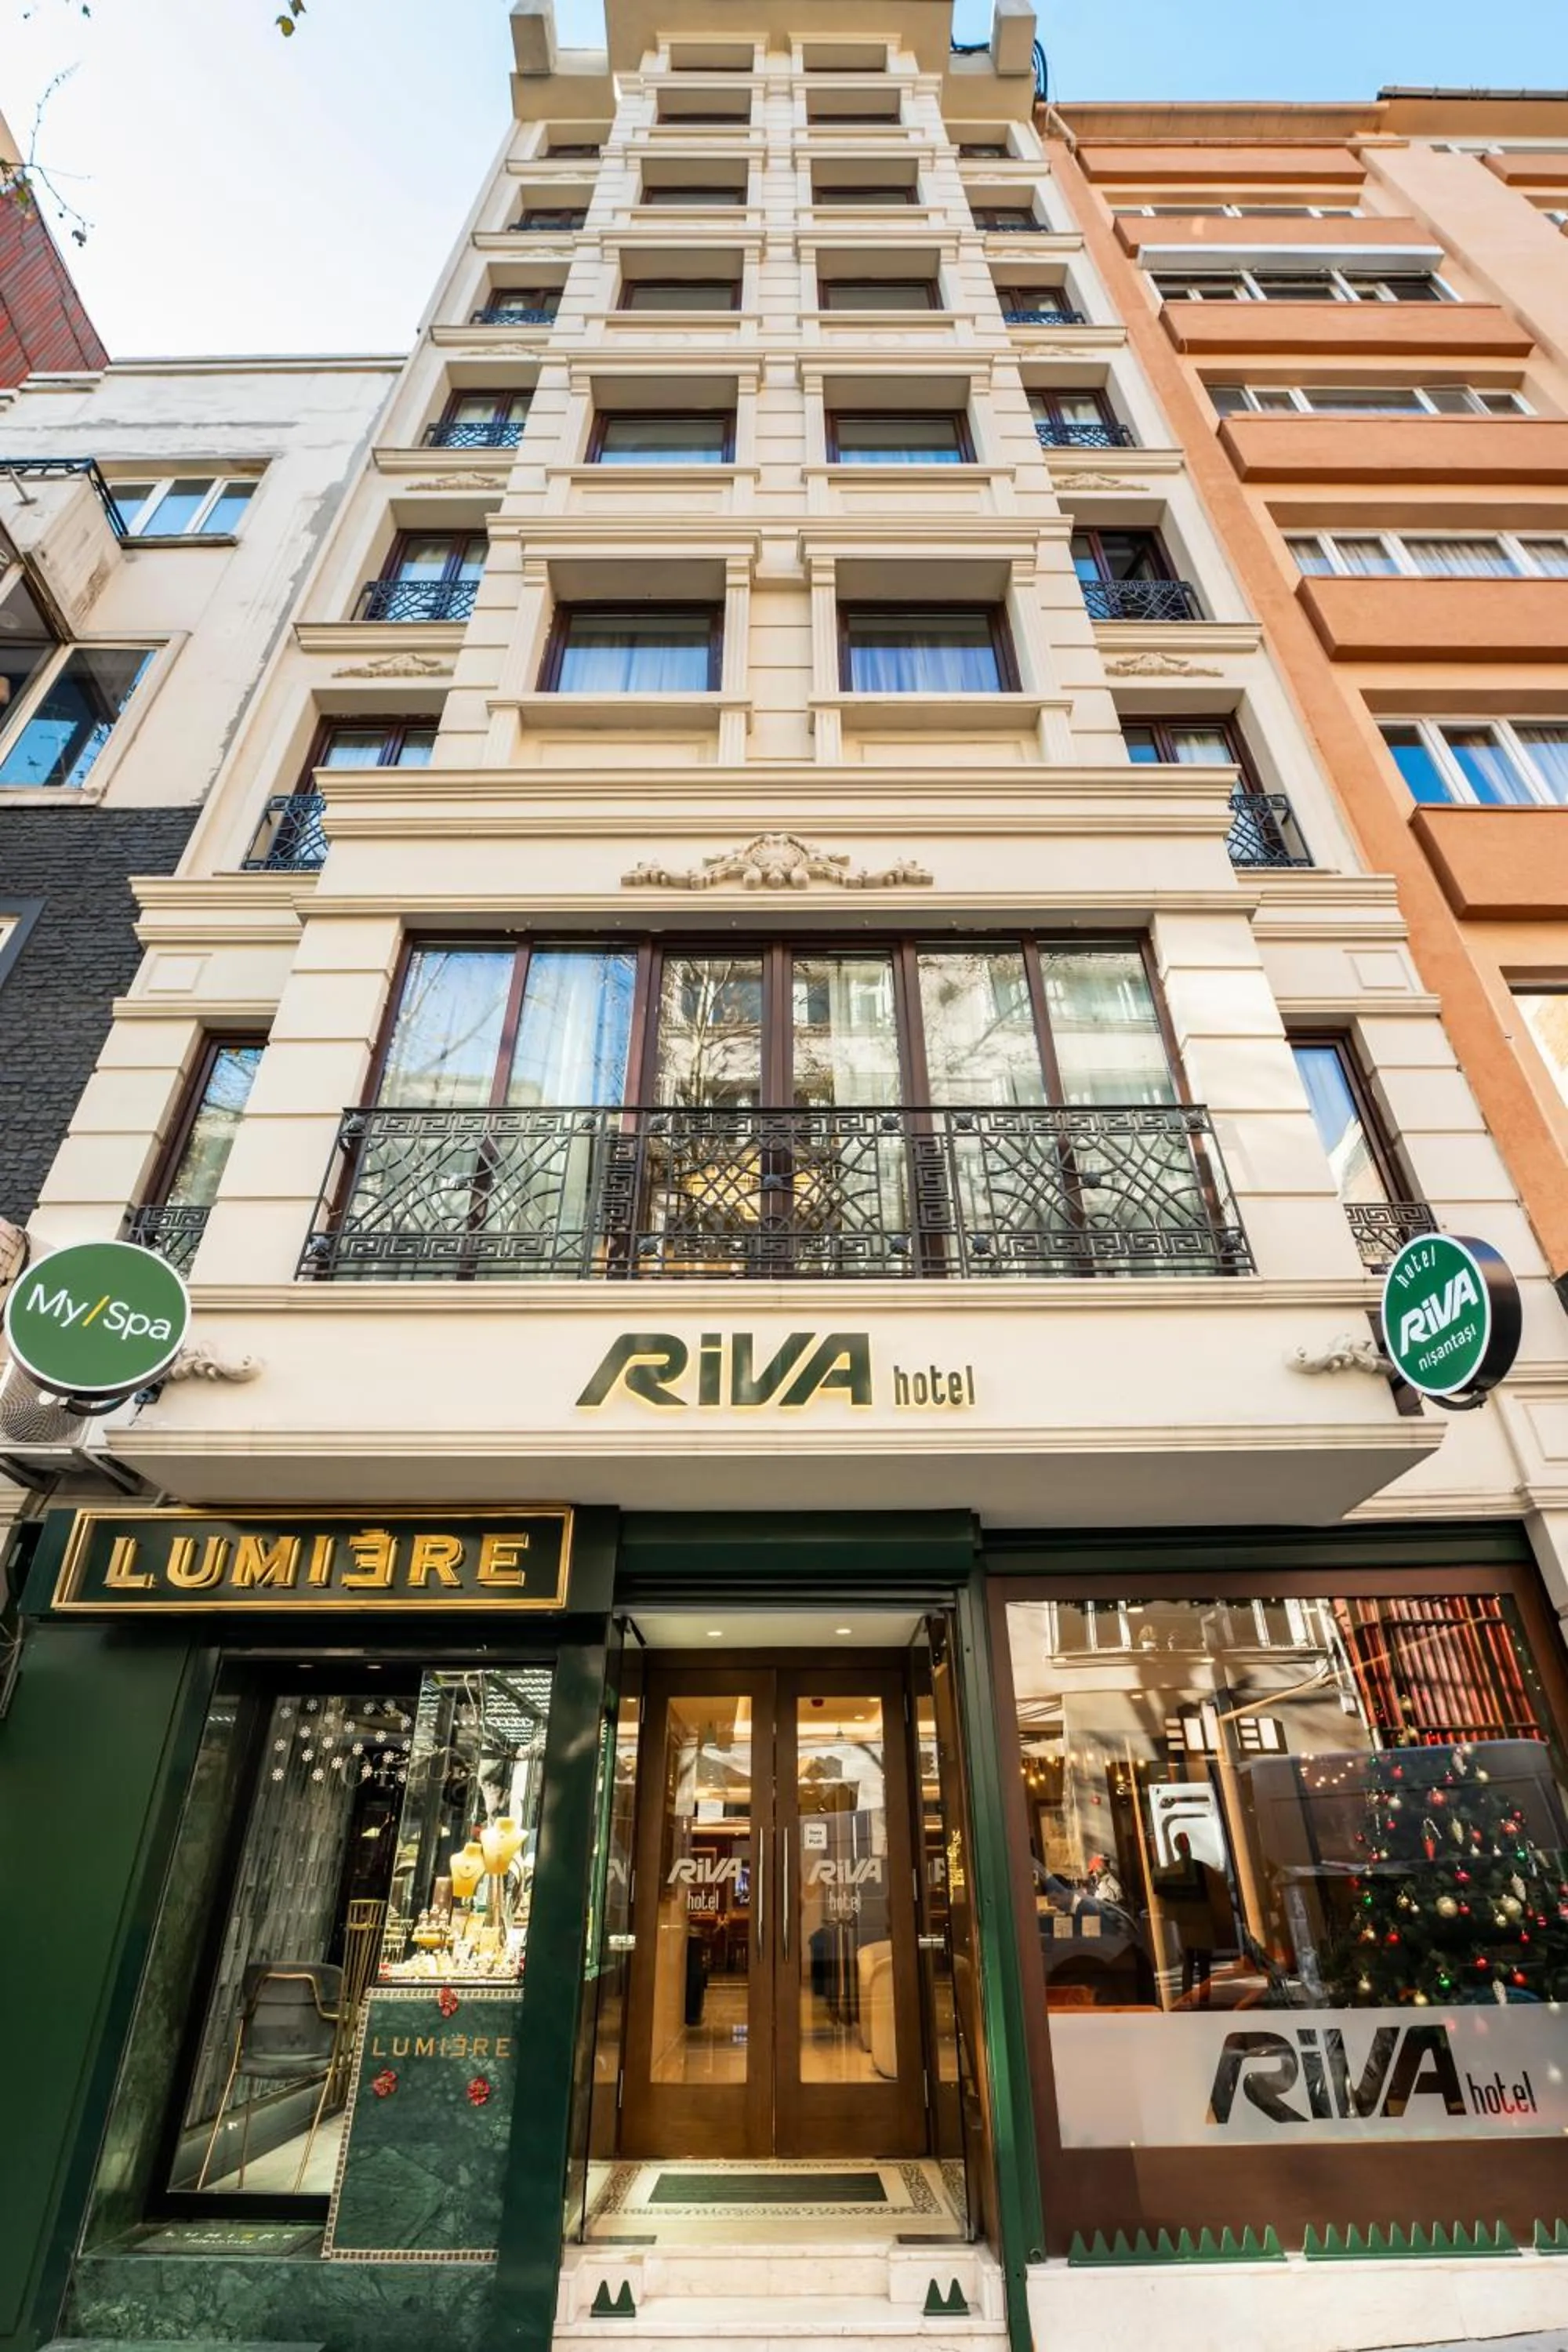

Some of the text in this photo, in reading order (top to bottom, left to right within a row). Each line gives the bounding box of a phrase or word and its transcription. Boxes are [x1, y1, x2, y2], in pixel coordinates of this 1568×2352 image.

[1396, 1245, 1436, 1288] hotel
[893, 1366, 975, 1406] hotel
[687, 1889, 719, 1911] hotel
[829, 1891, 861, 1911] hotel
[1466, 2071, 1537, 2114] hotel
